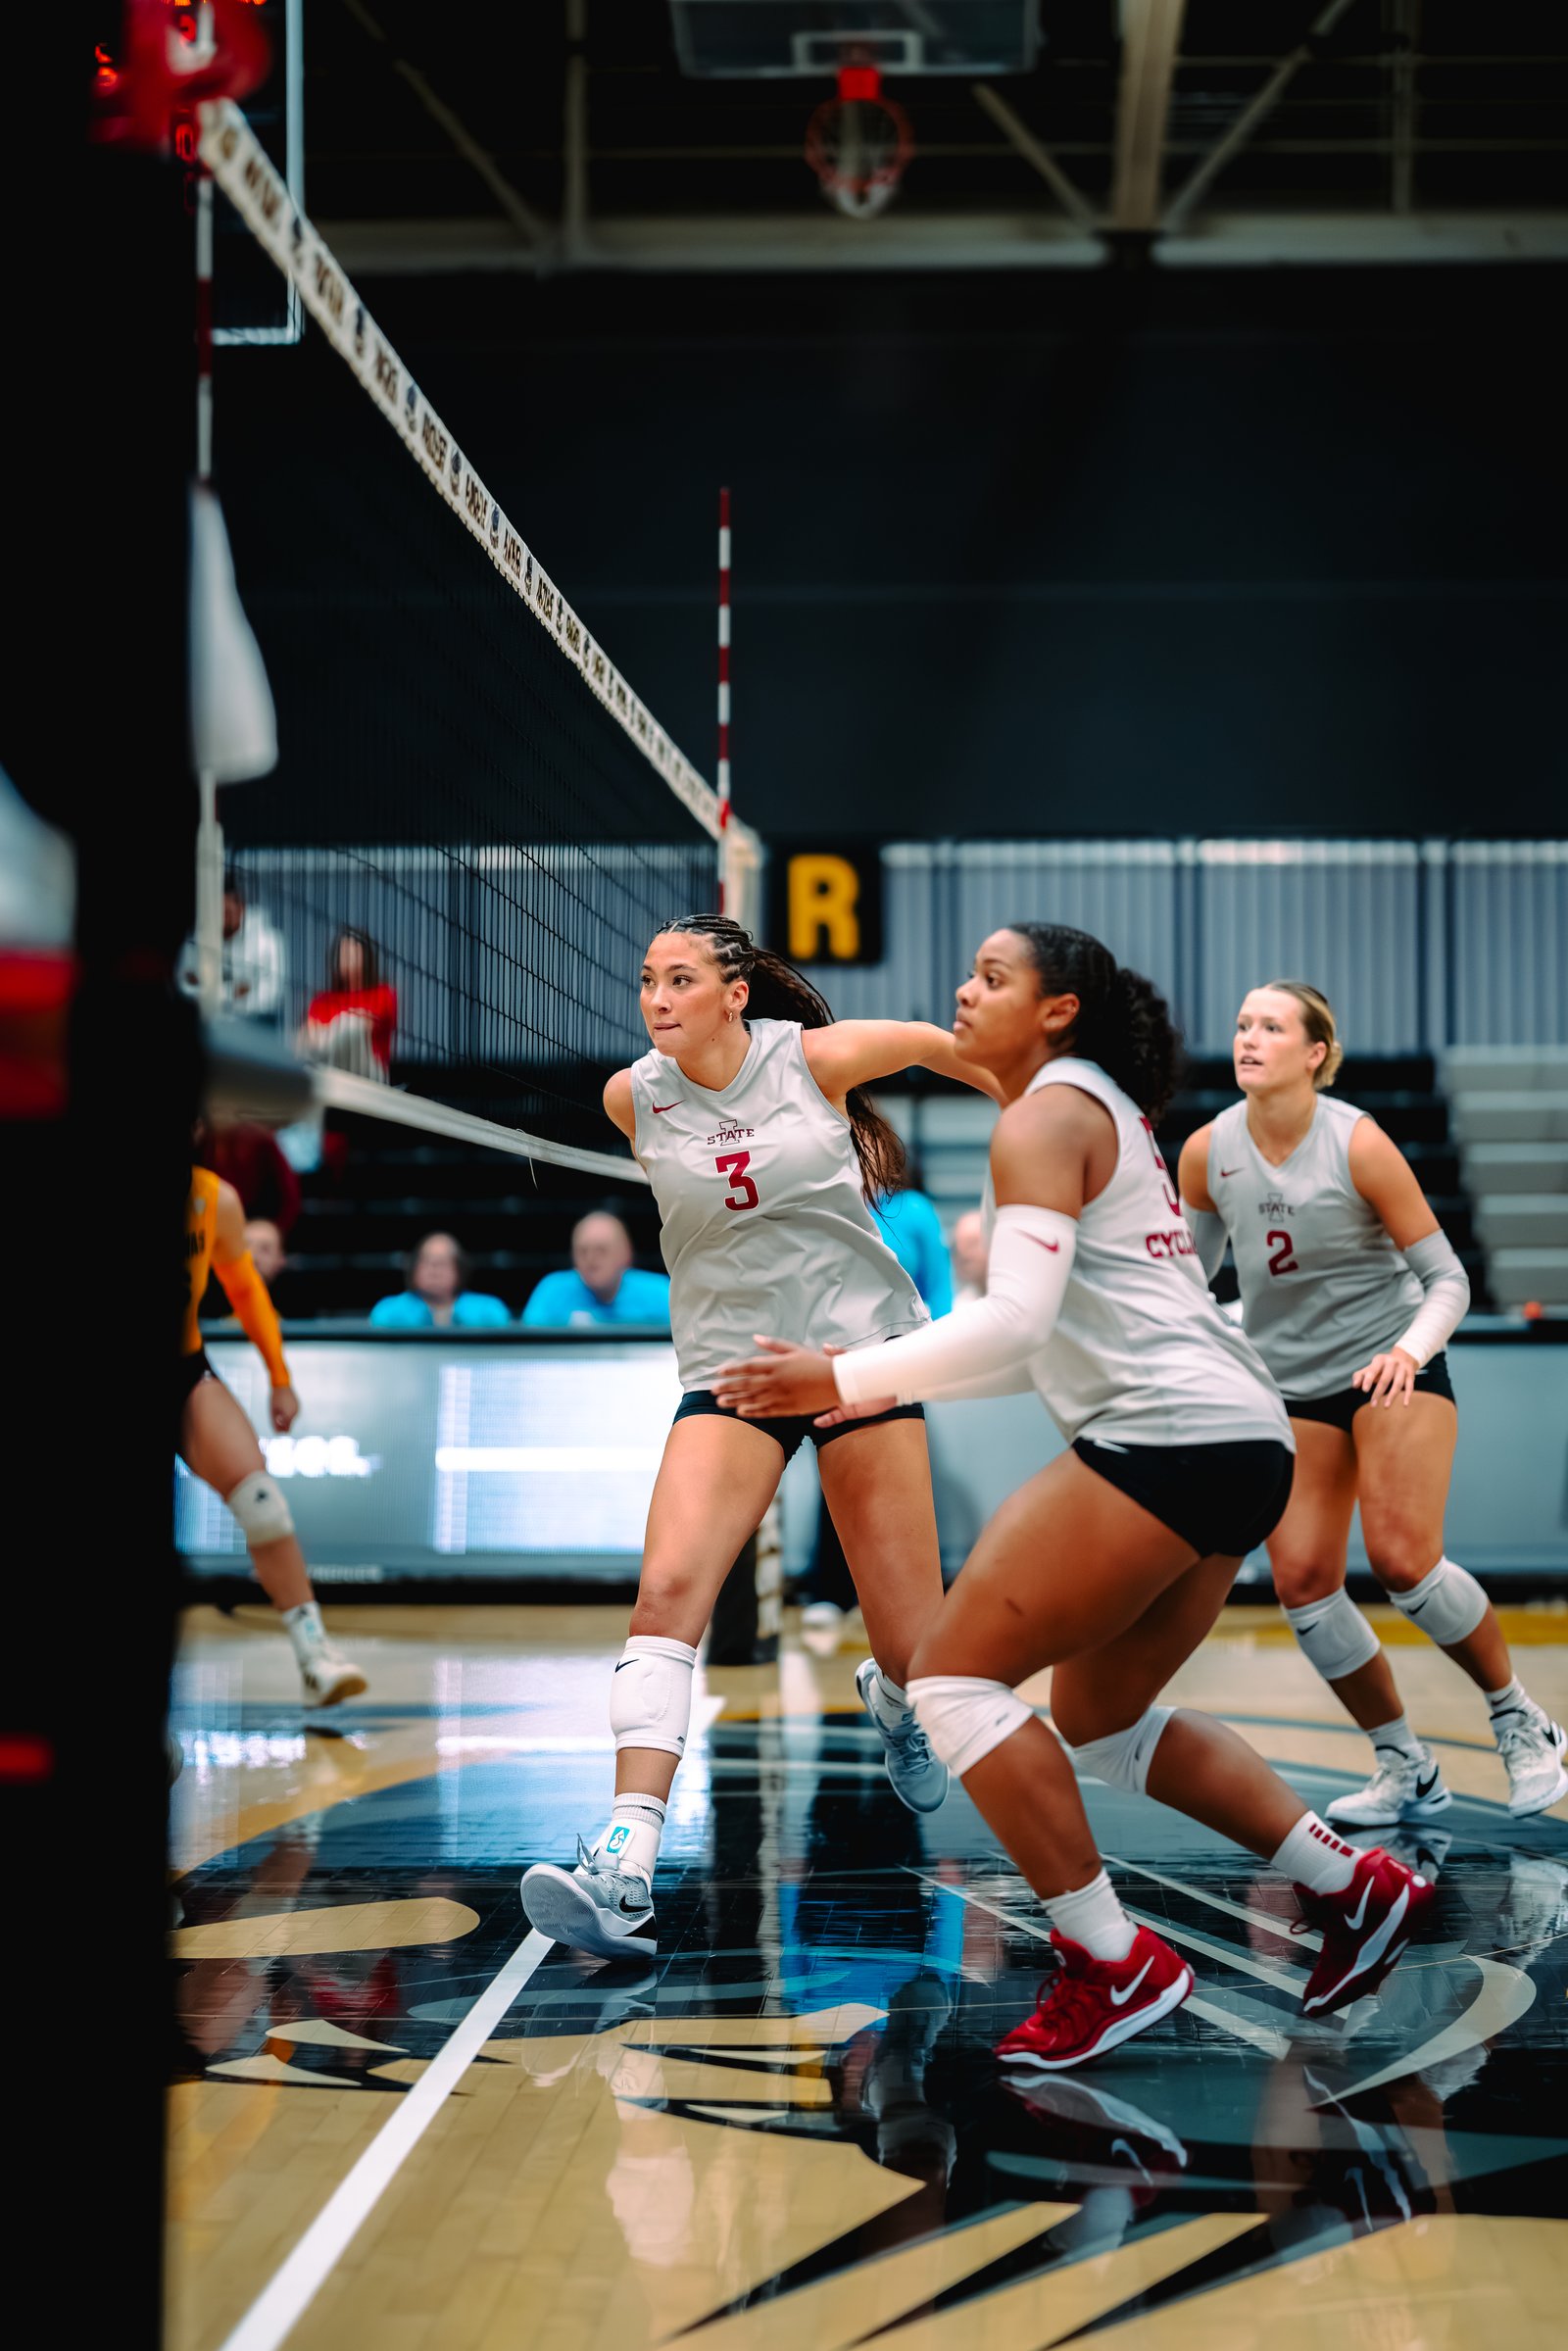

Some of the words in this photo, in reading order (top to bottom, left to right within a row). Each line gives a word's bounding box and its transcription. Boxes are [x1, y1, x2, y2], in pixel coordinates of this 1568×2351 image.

[788, 853, 859, 960] R
[707, 1128, 756, 1146] STATE
[714, 1150, 760, 1211] 3
[1258, 1202, 1295, 1217] STATE
[1145, 1229, 1199, 1258] CYCL
[1266, 1230, 1298, 1277] 2
